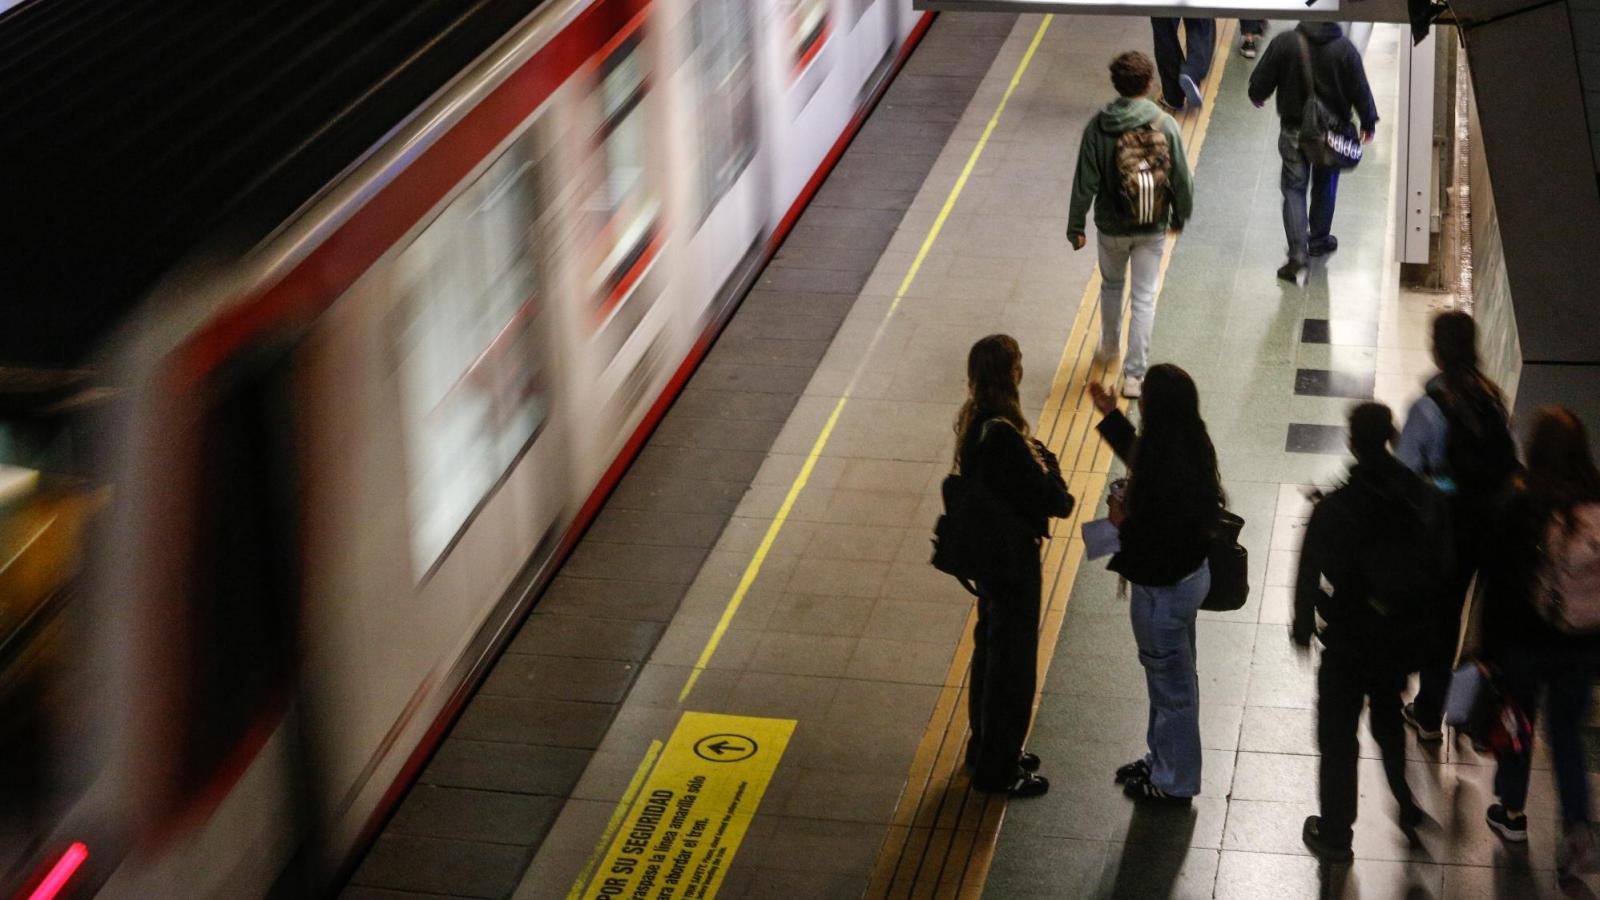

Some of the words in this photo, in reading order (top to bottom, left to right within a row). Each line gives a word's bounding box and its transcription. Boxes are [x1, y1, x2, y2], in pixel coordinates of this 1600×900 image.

[687, 776, 706, 793] sólo
[622, 790, 674, 854] SEGURIDAD
[670, 795, 696, 829] amarilla
[686, 818, 709, 837] tren.
[653, 831, 678, 852] línea
[682, 839, 699, 848] el
[611, 858, 638, 874] SU
[648, 854, 666, 862] la
[665, 849, 692, 884] abordar
[596, 878, 628, 900] POR
[631, 864, 660, 900] raspase
[657, 887, 675, 900] ara
